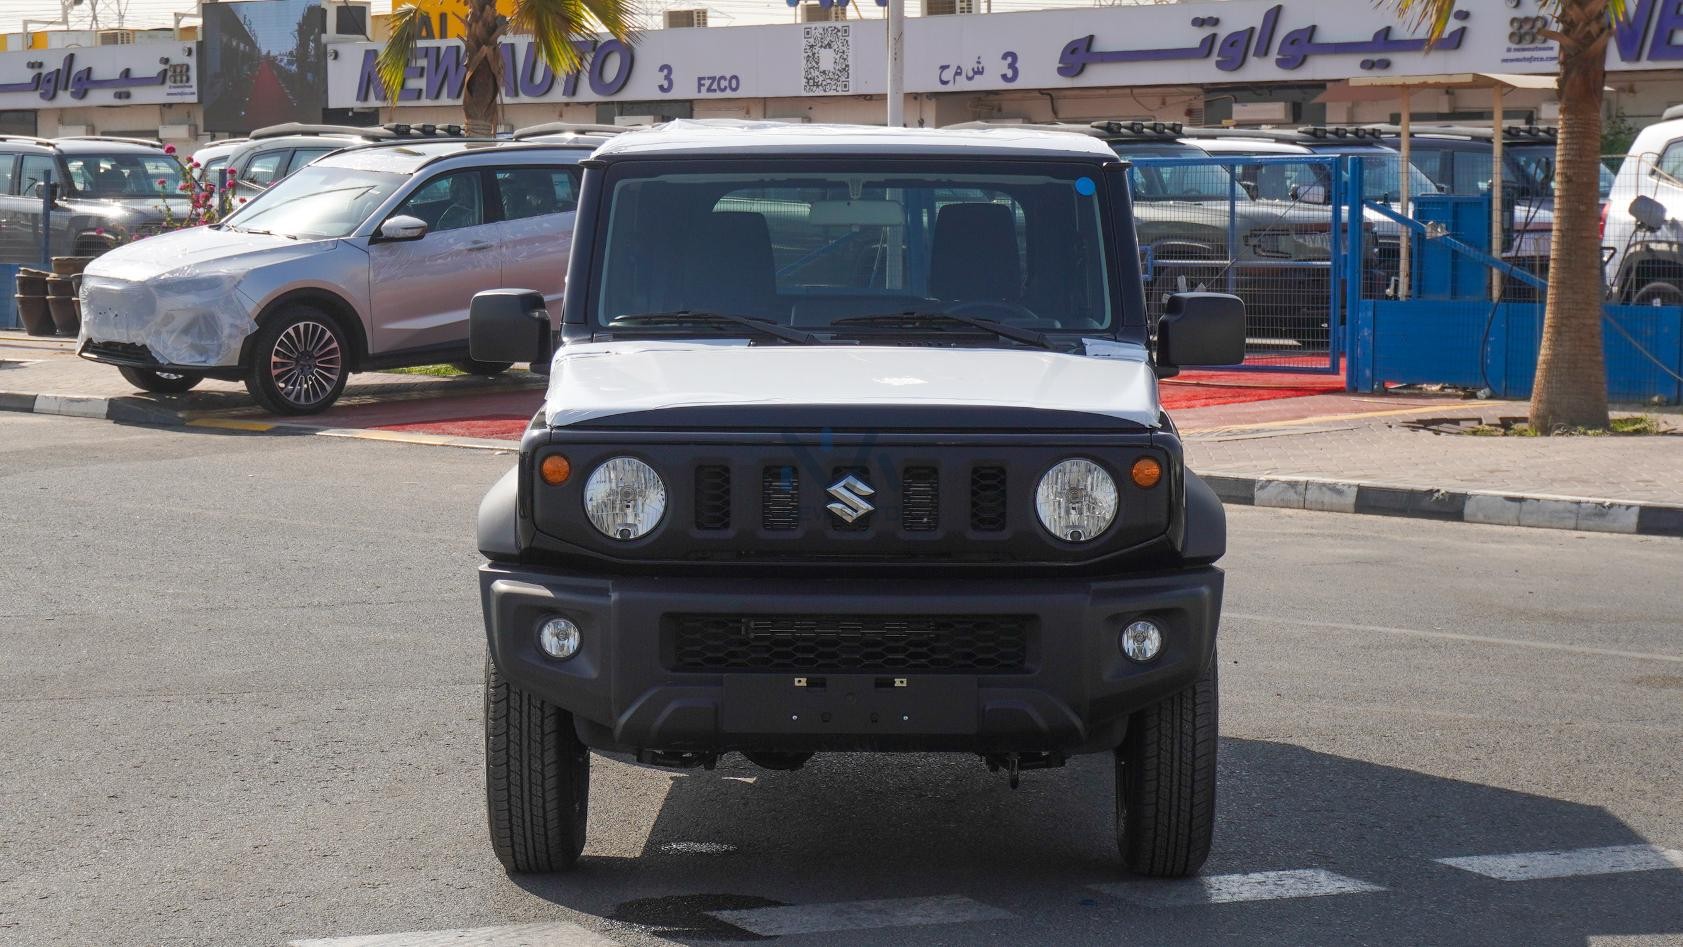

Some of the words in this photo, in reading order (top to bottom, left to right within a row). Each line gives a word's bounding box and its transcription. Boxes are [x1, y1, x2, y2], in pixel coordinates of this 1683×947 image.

[657, 63, 674, 94] 3
[697, 74, 740, 94] FZCO
[1001, 51, 1019, 83] 3
